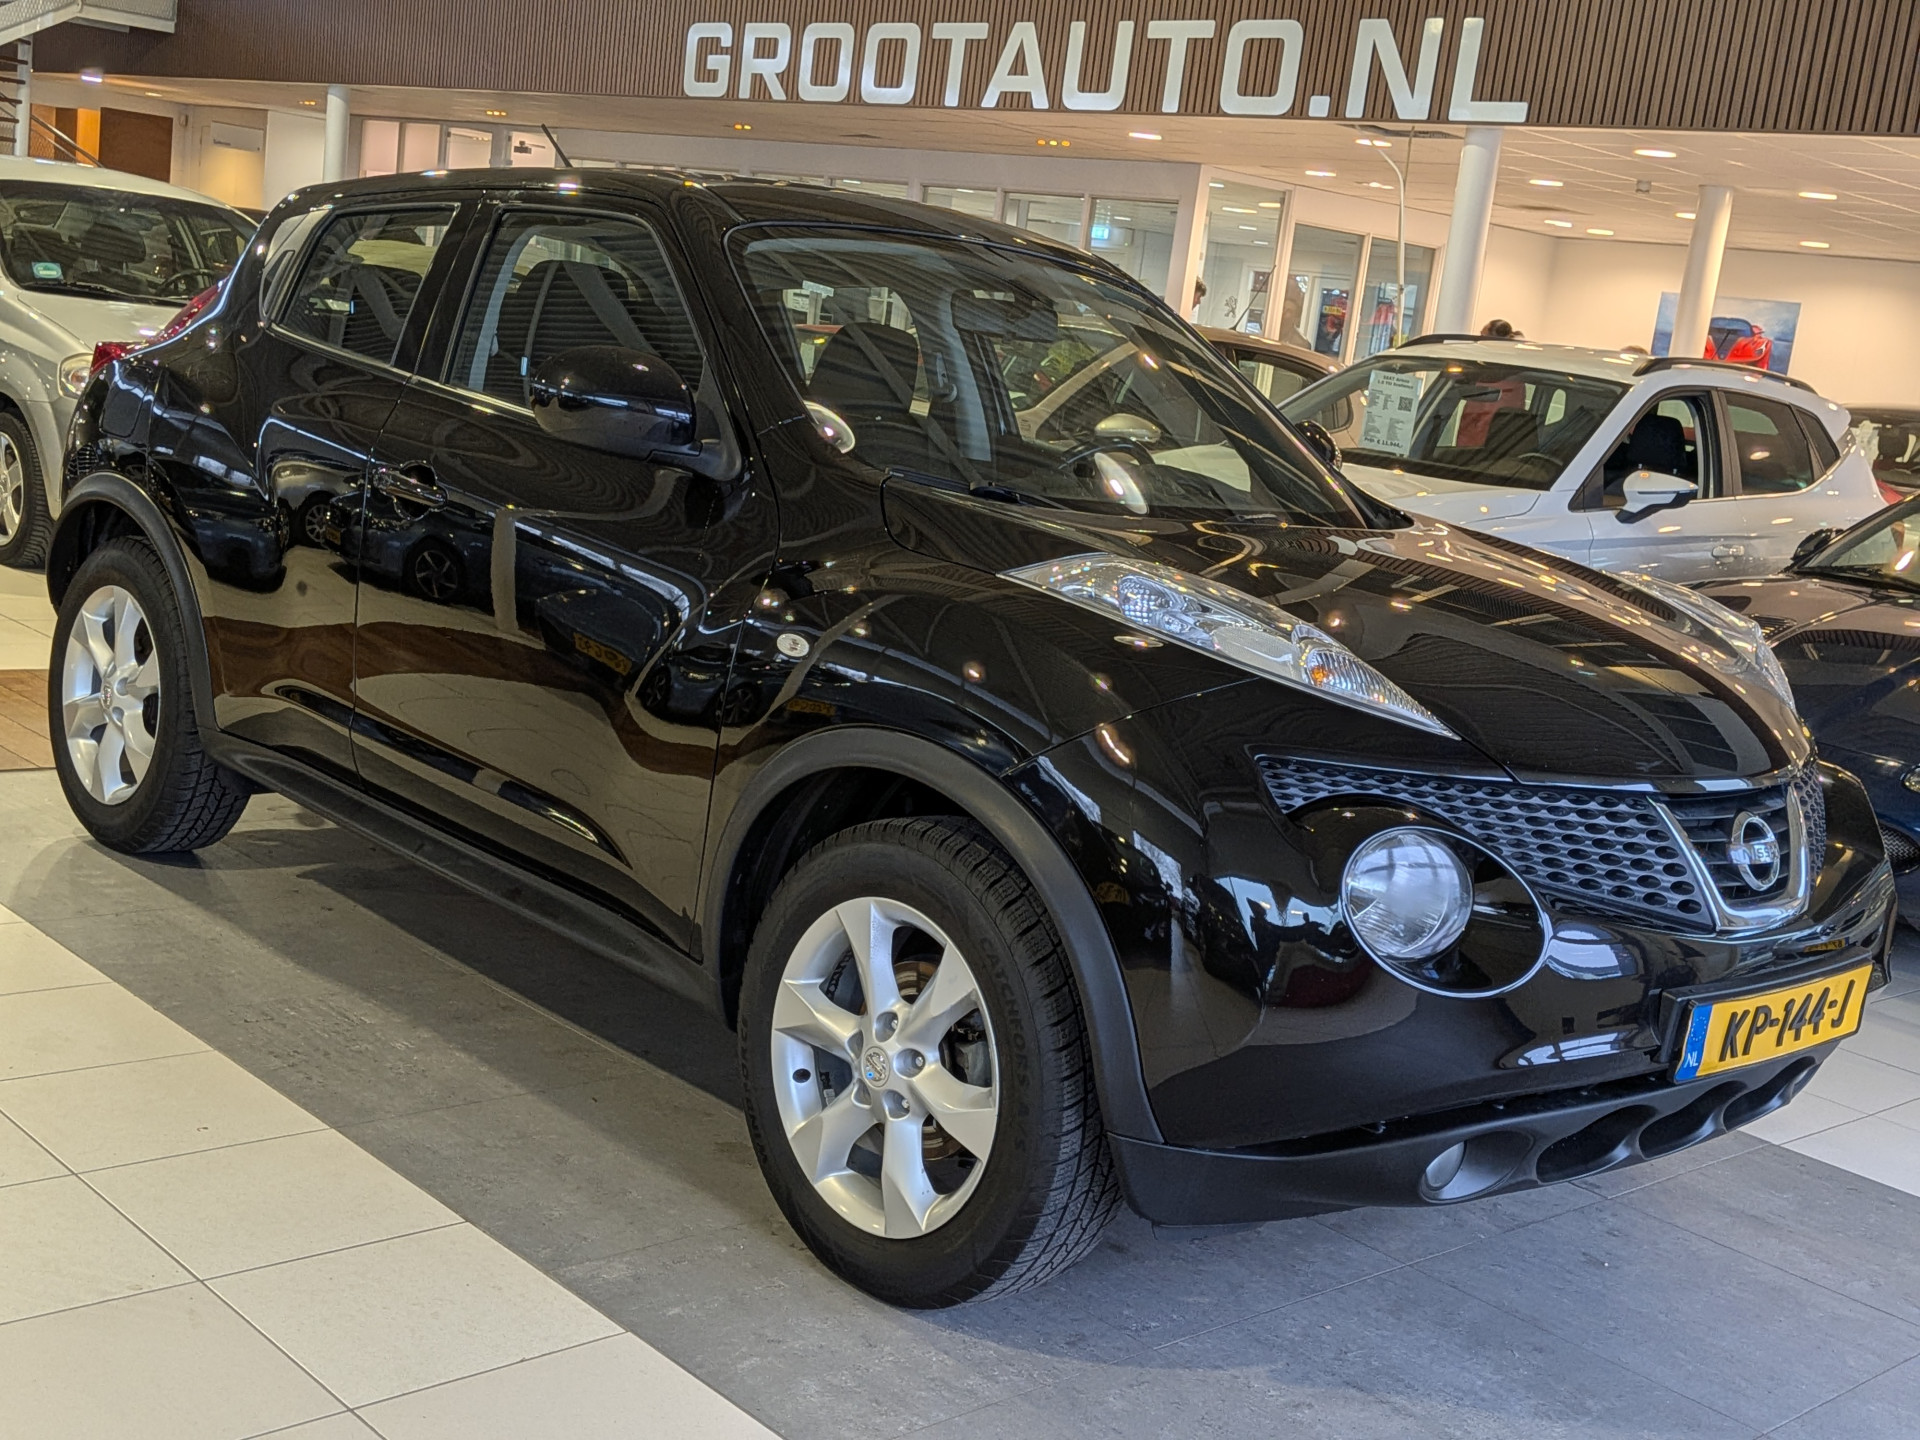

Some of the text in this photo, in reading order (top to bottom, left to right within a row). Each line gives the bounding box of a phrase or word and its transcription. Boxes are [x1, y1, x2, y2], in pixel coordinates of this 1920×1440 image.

[684, 17, 1529, 123] GROOTAUTO.NL
[1684, 1051, 1699, 1068] NL
[1719, 979, 1855, 1062] KP-144-J
